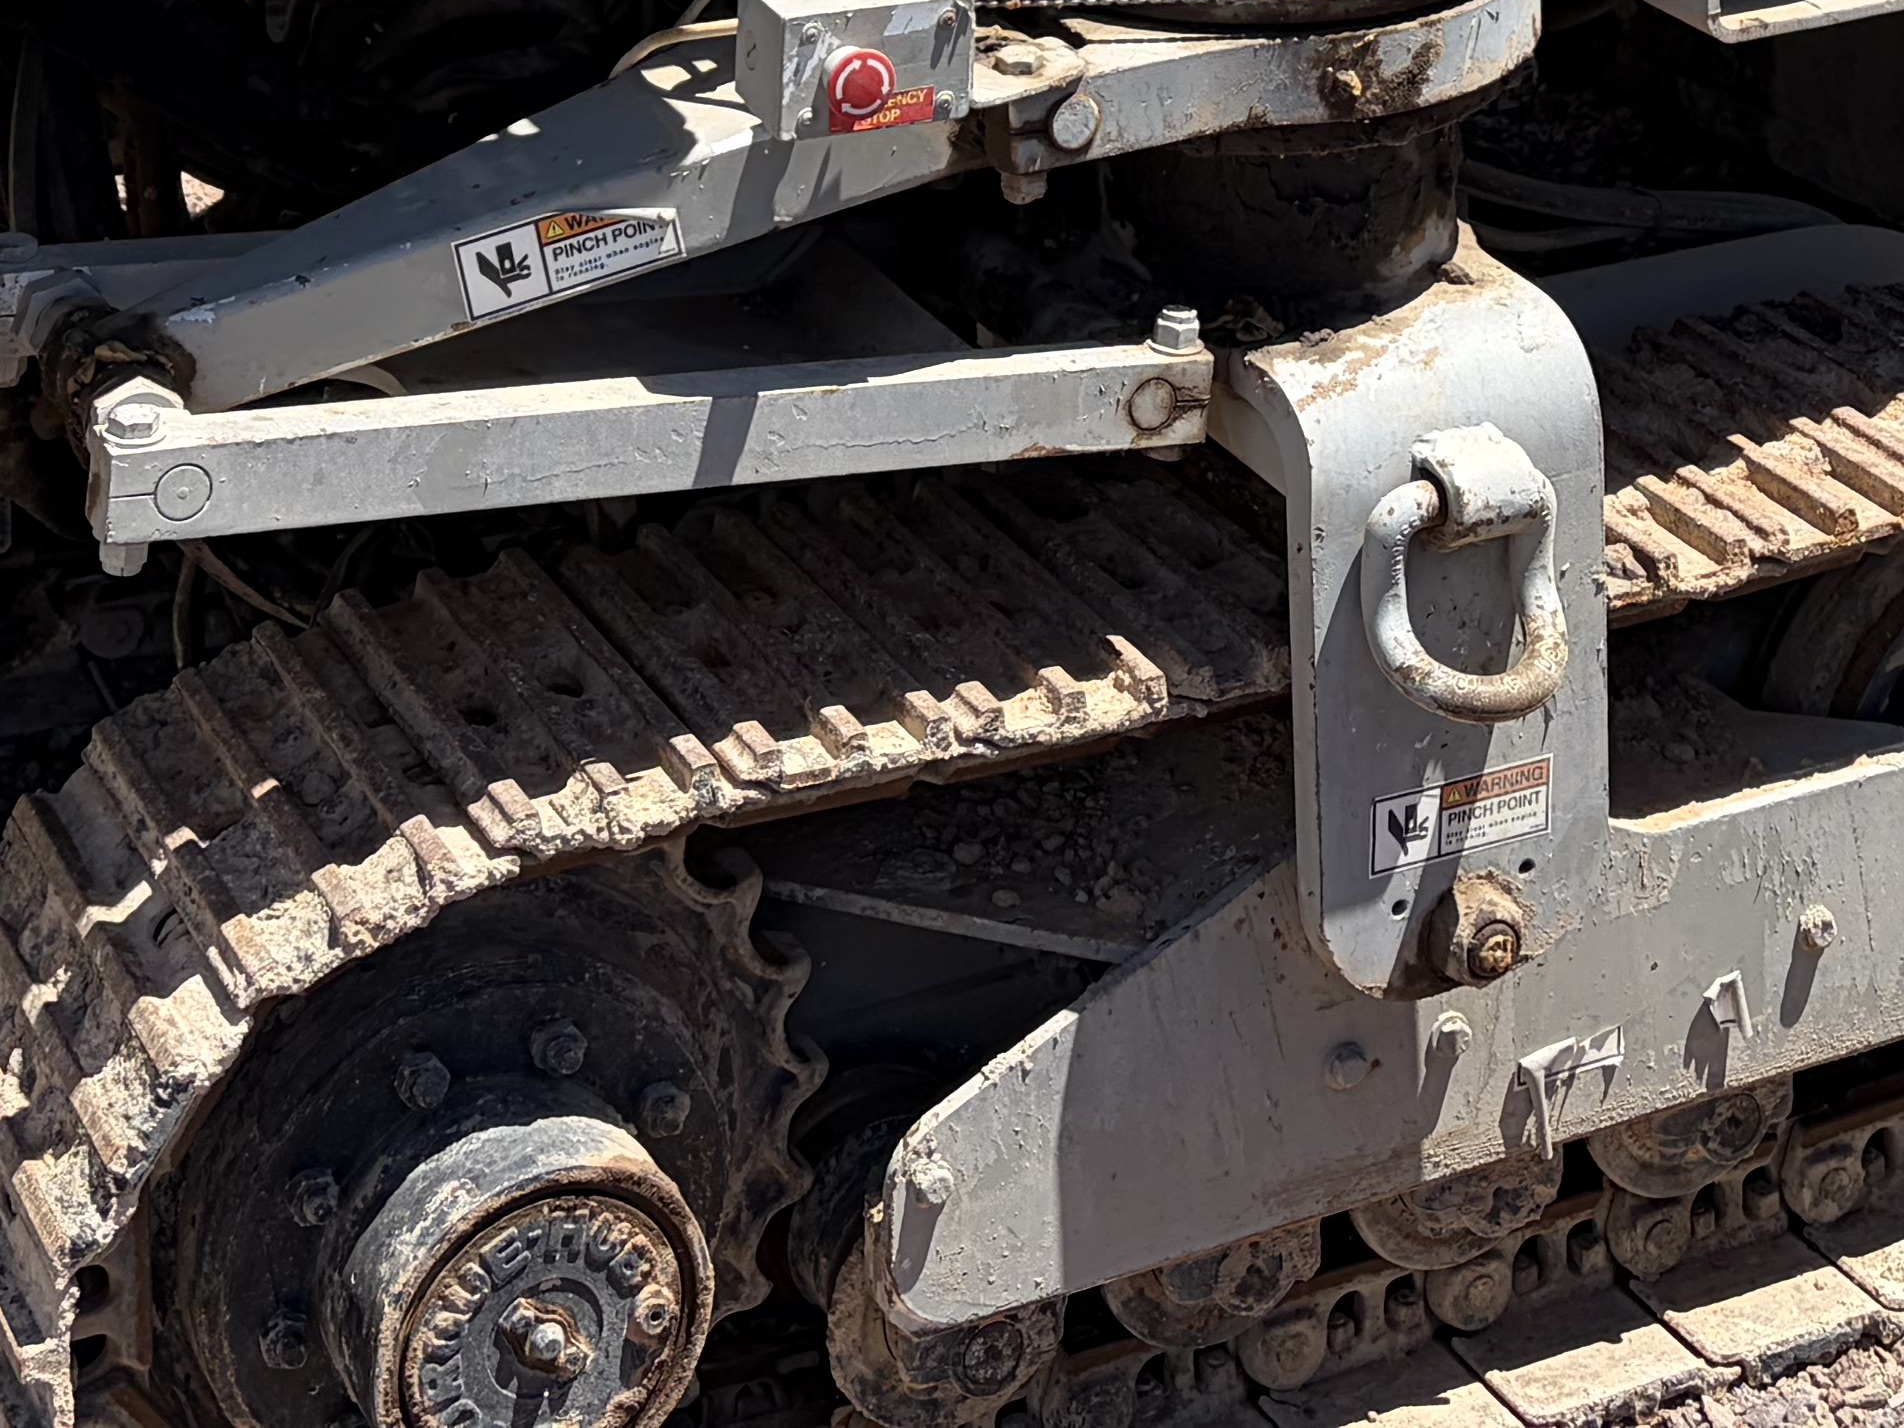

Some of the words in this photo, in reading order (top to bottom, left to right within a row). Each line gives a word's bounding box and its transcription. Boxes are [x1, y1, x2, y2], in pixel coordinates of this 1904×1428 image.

[553, 233, 608, 262] PINCH
[612, 220, 664, 247] POIN
[1464, 766, 1544, 796] WARNING
[1448, 800, 1494, 826] PINCH
[1497, 790, 1542, 814] POINT
